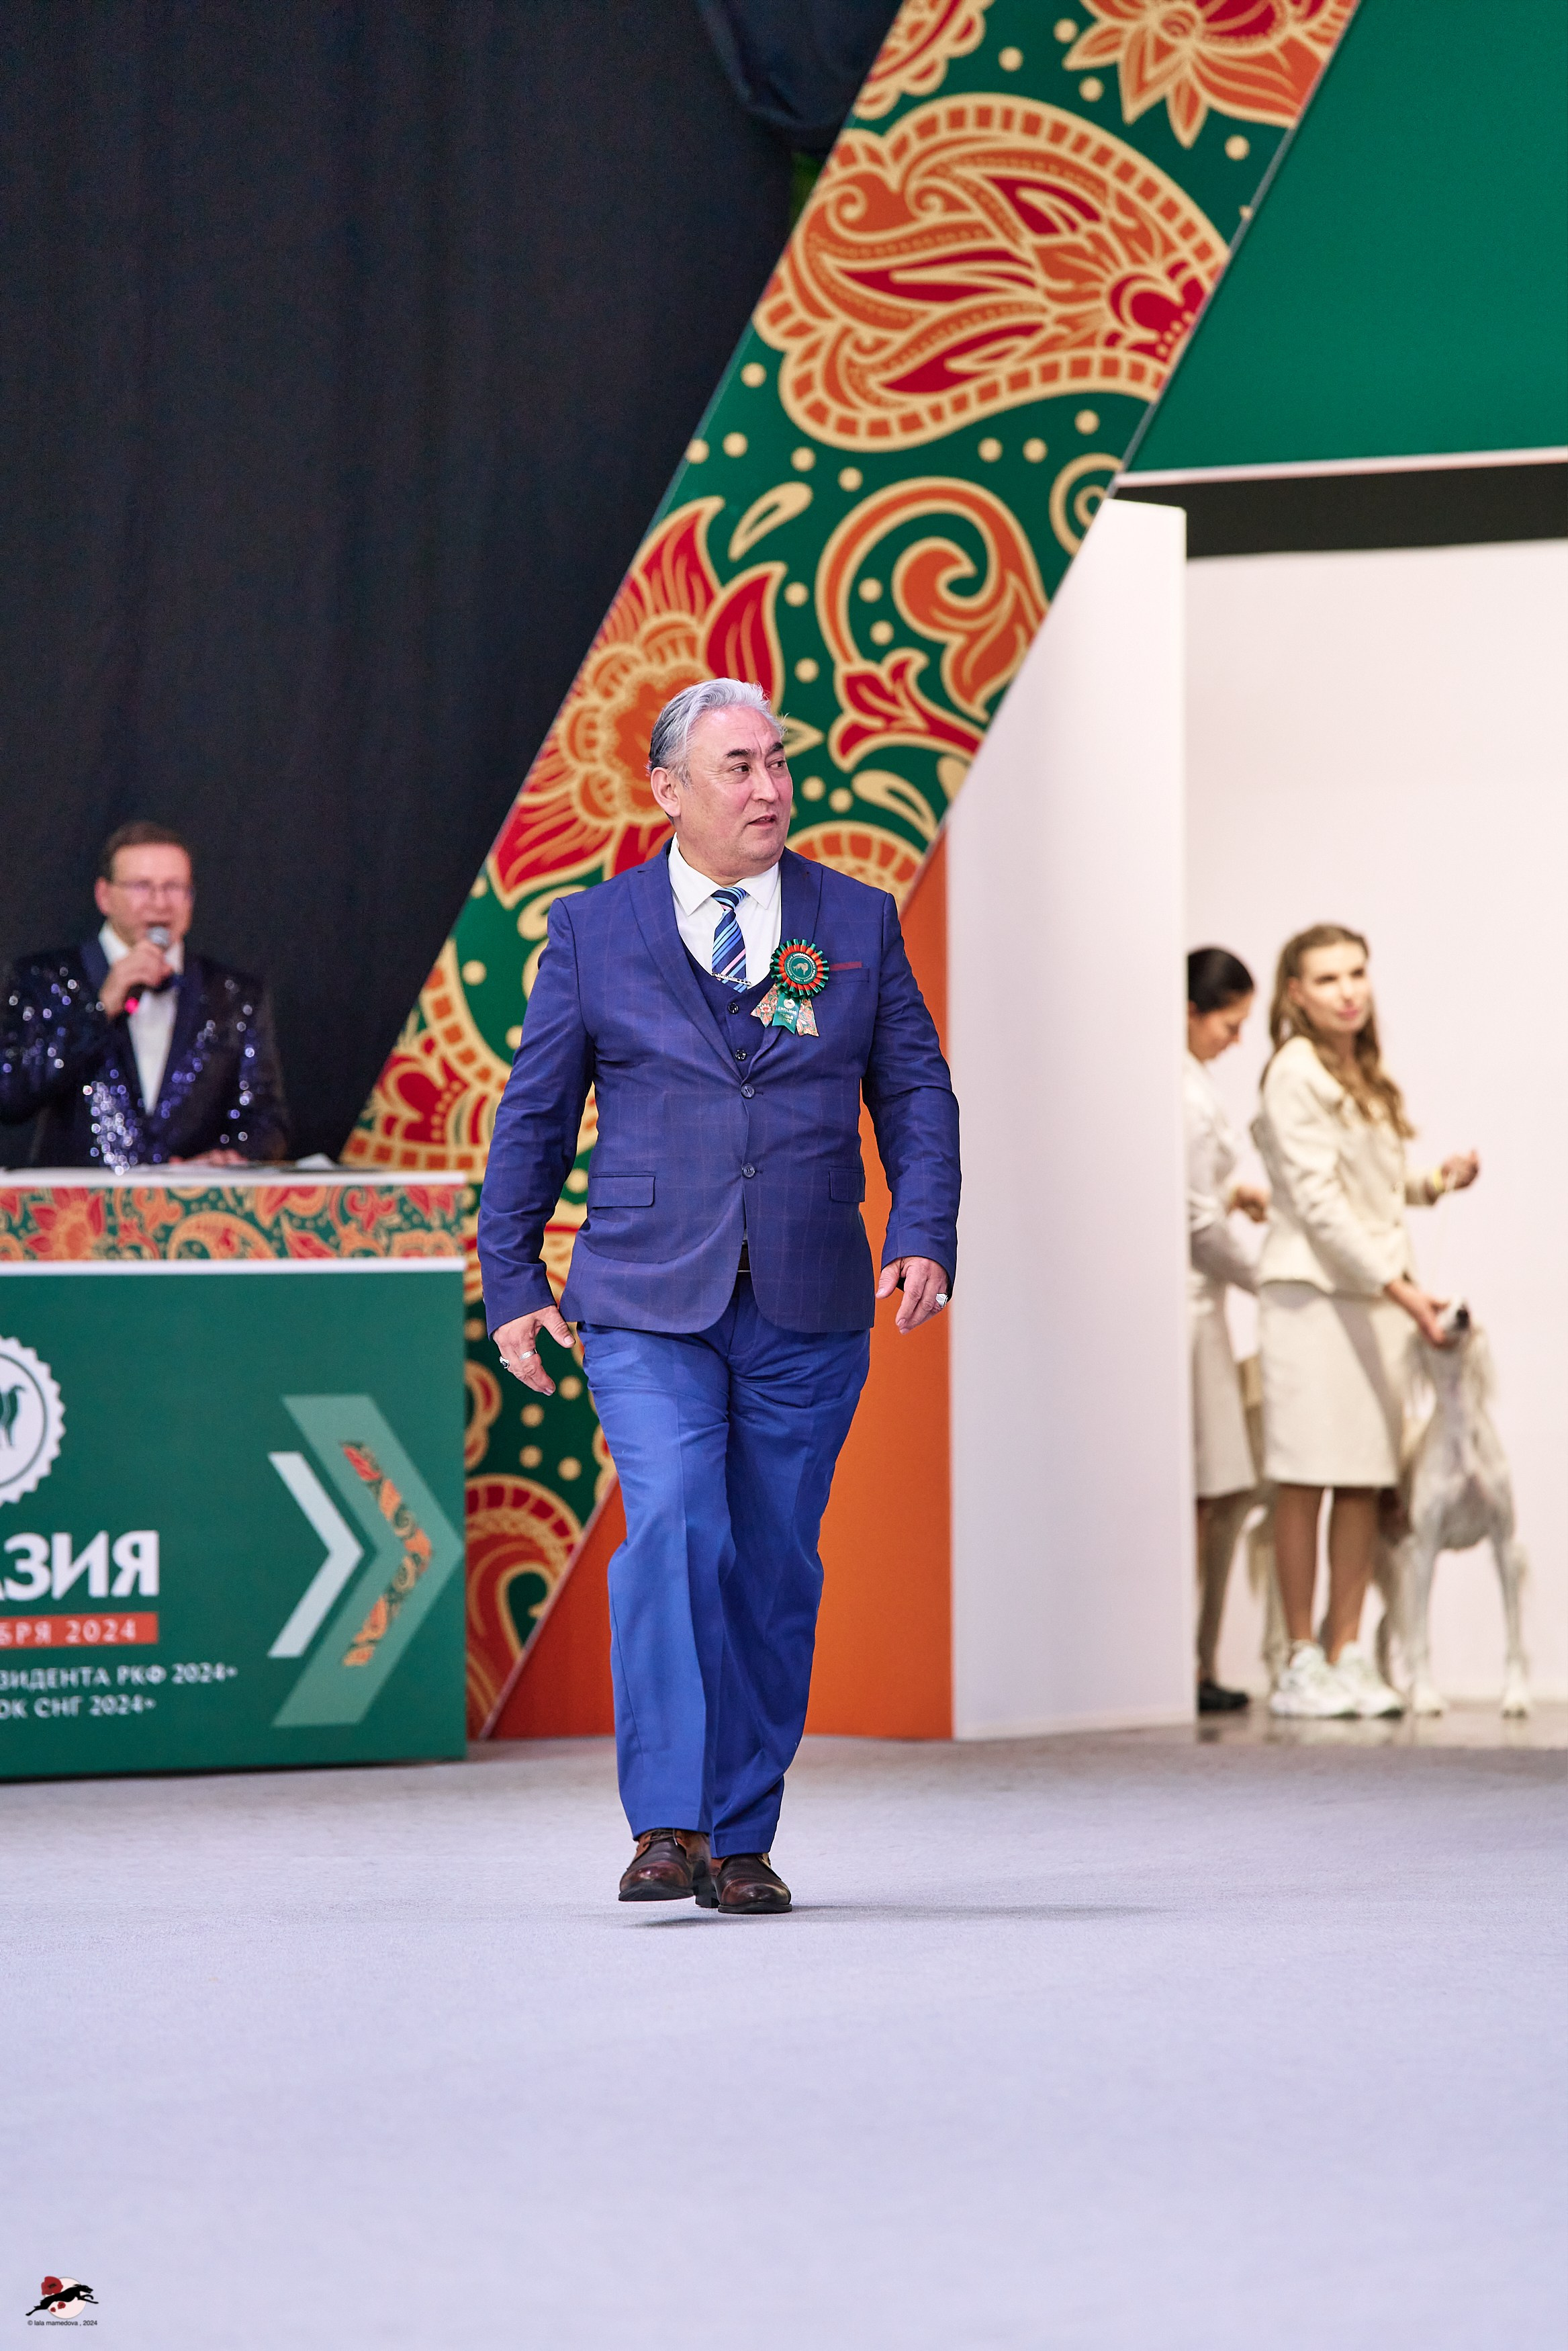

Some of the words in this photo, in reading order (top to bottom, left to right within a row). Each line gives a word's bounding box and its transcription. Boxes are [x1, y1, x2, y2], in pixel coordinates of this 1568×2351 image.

[0, 1529, 160, 1601] ЗИЯ
[0, 1621, 52, 1645] БРЯ
[65, 1619, 136, 1644] 2024
[117, 1664, 167, 1686] РКФ
[34, 1695, 82, 1718] СНГ
